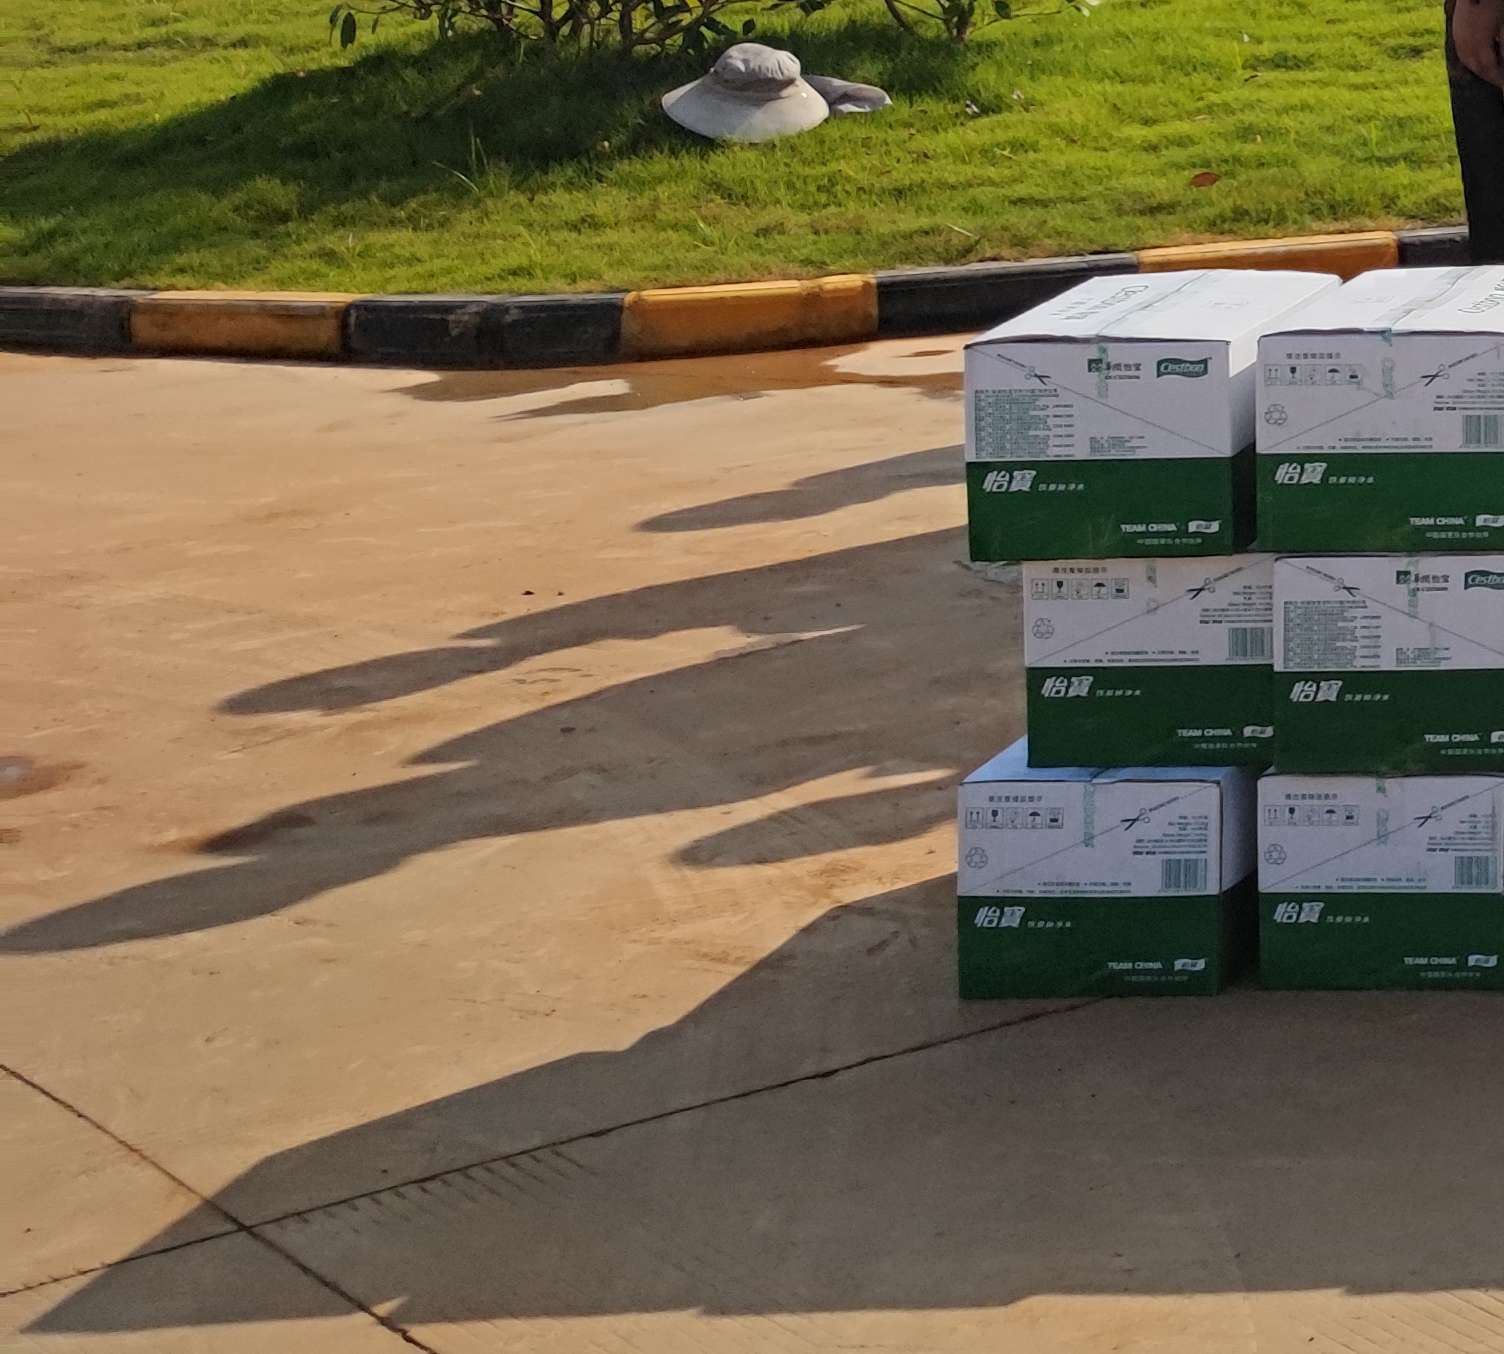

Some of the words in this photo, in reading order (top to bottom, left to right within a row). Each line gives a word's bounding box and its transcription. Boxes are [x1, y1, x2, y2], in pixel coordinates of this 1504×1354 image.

[1409, 517, 1435, 526] TEAM
[1120, 524, 1146, 532] TEAM
[1177, 728, 1202, 738] TEAM
[1424, 734, 1450, 743] TEAM
[1403, 956, 1429, 966] TEAM
[1108, 961, 1133, 971] TEAM
